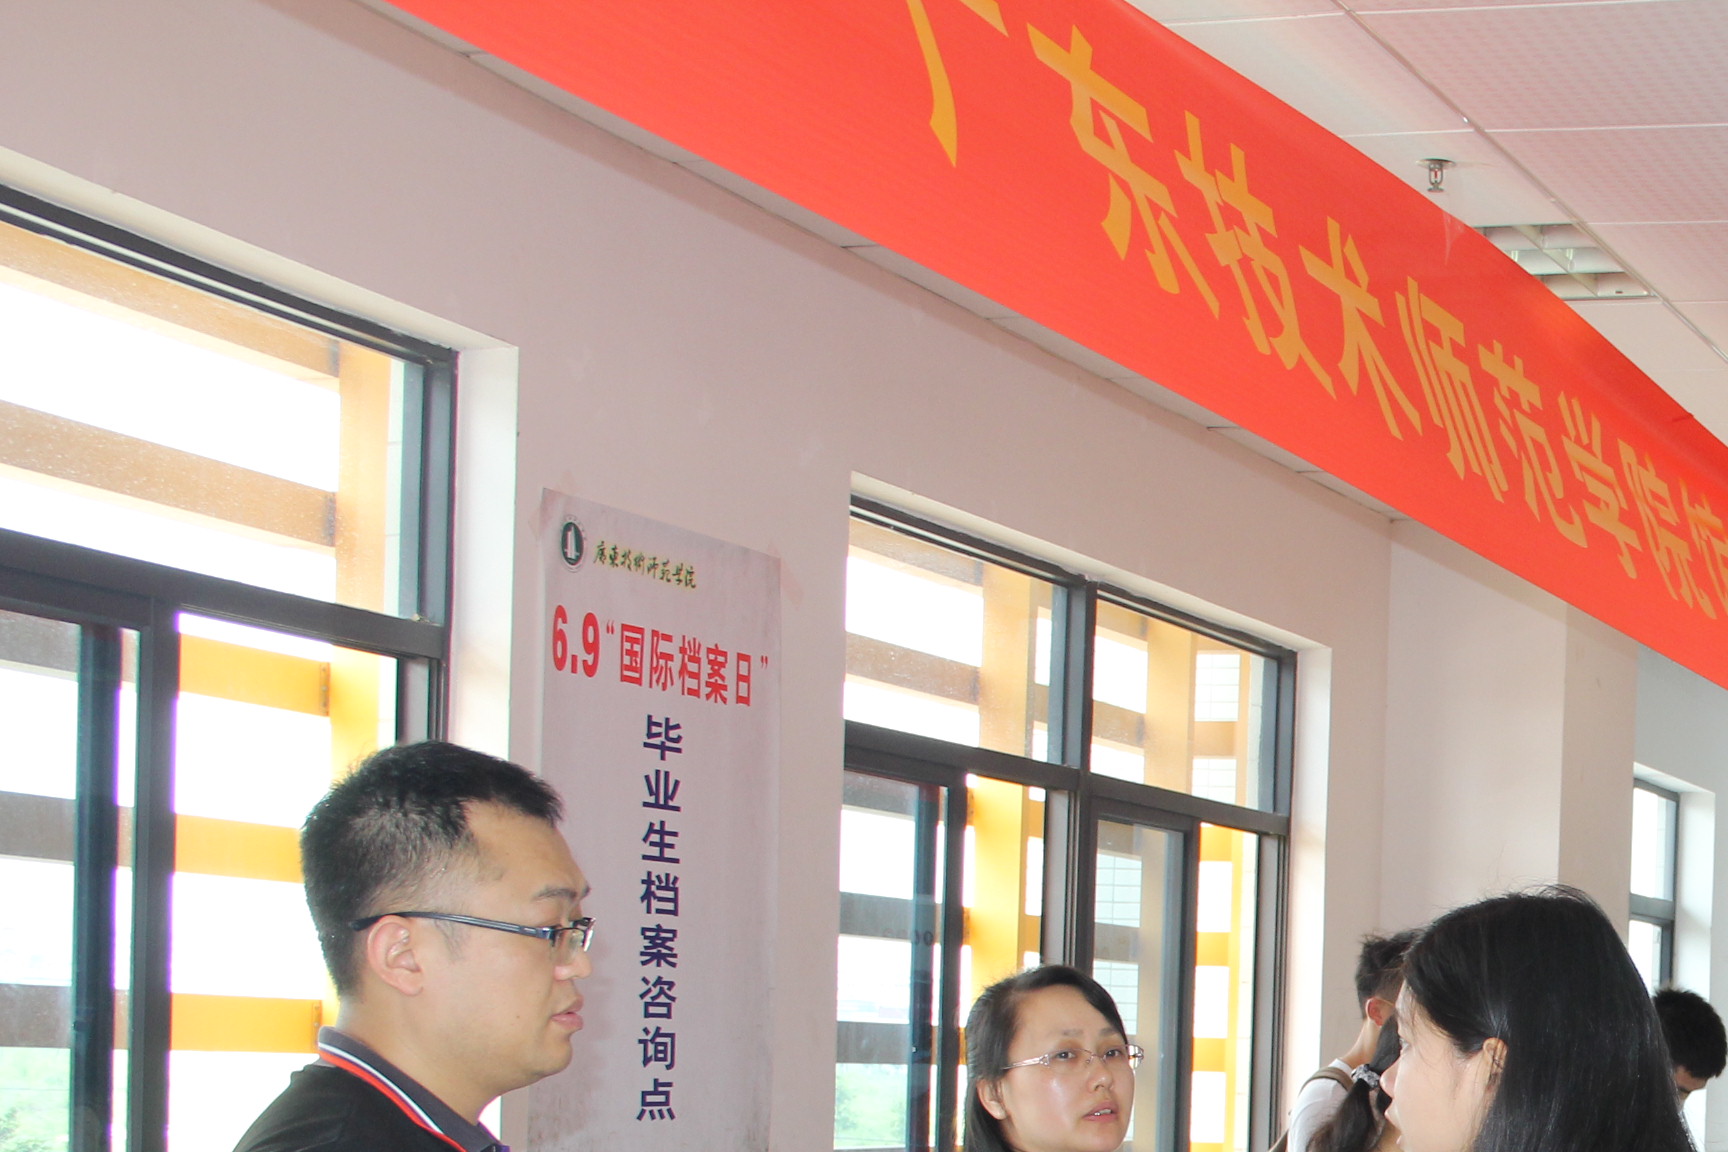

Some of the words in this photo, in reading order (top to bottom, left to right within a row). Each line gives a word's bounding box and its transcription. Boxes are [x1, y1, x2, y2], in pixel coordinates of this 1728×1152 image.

[636, 714, 684, 1121] 毕业生档案咨询点
